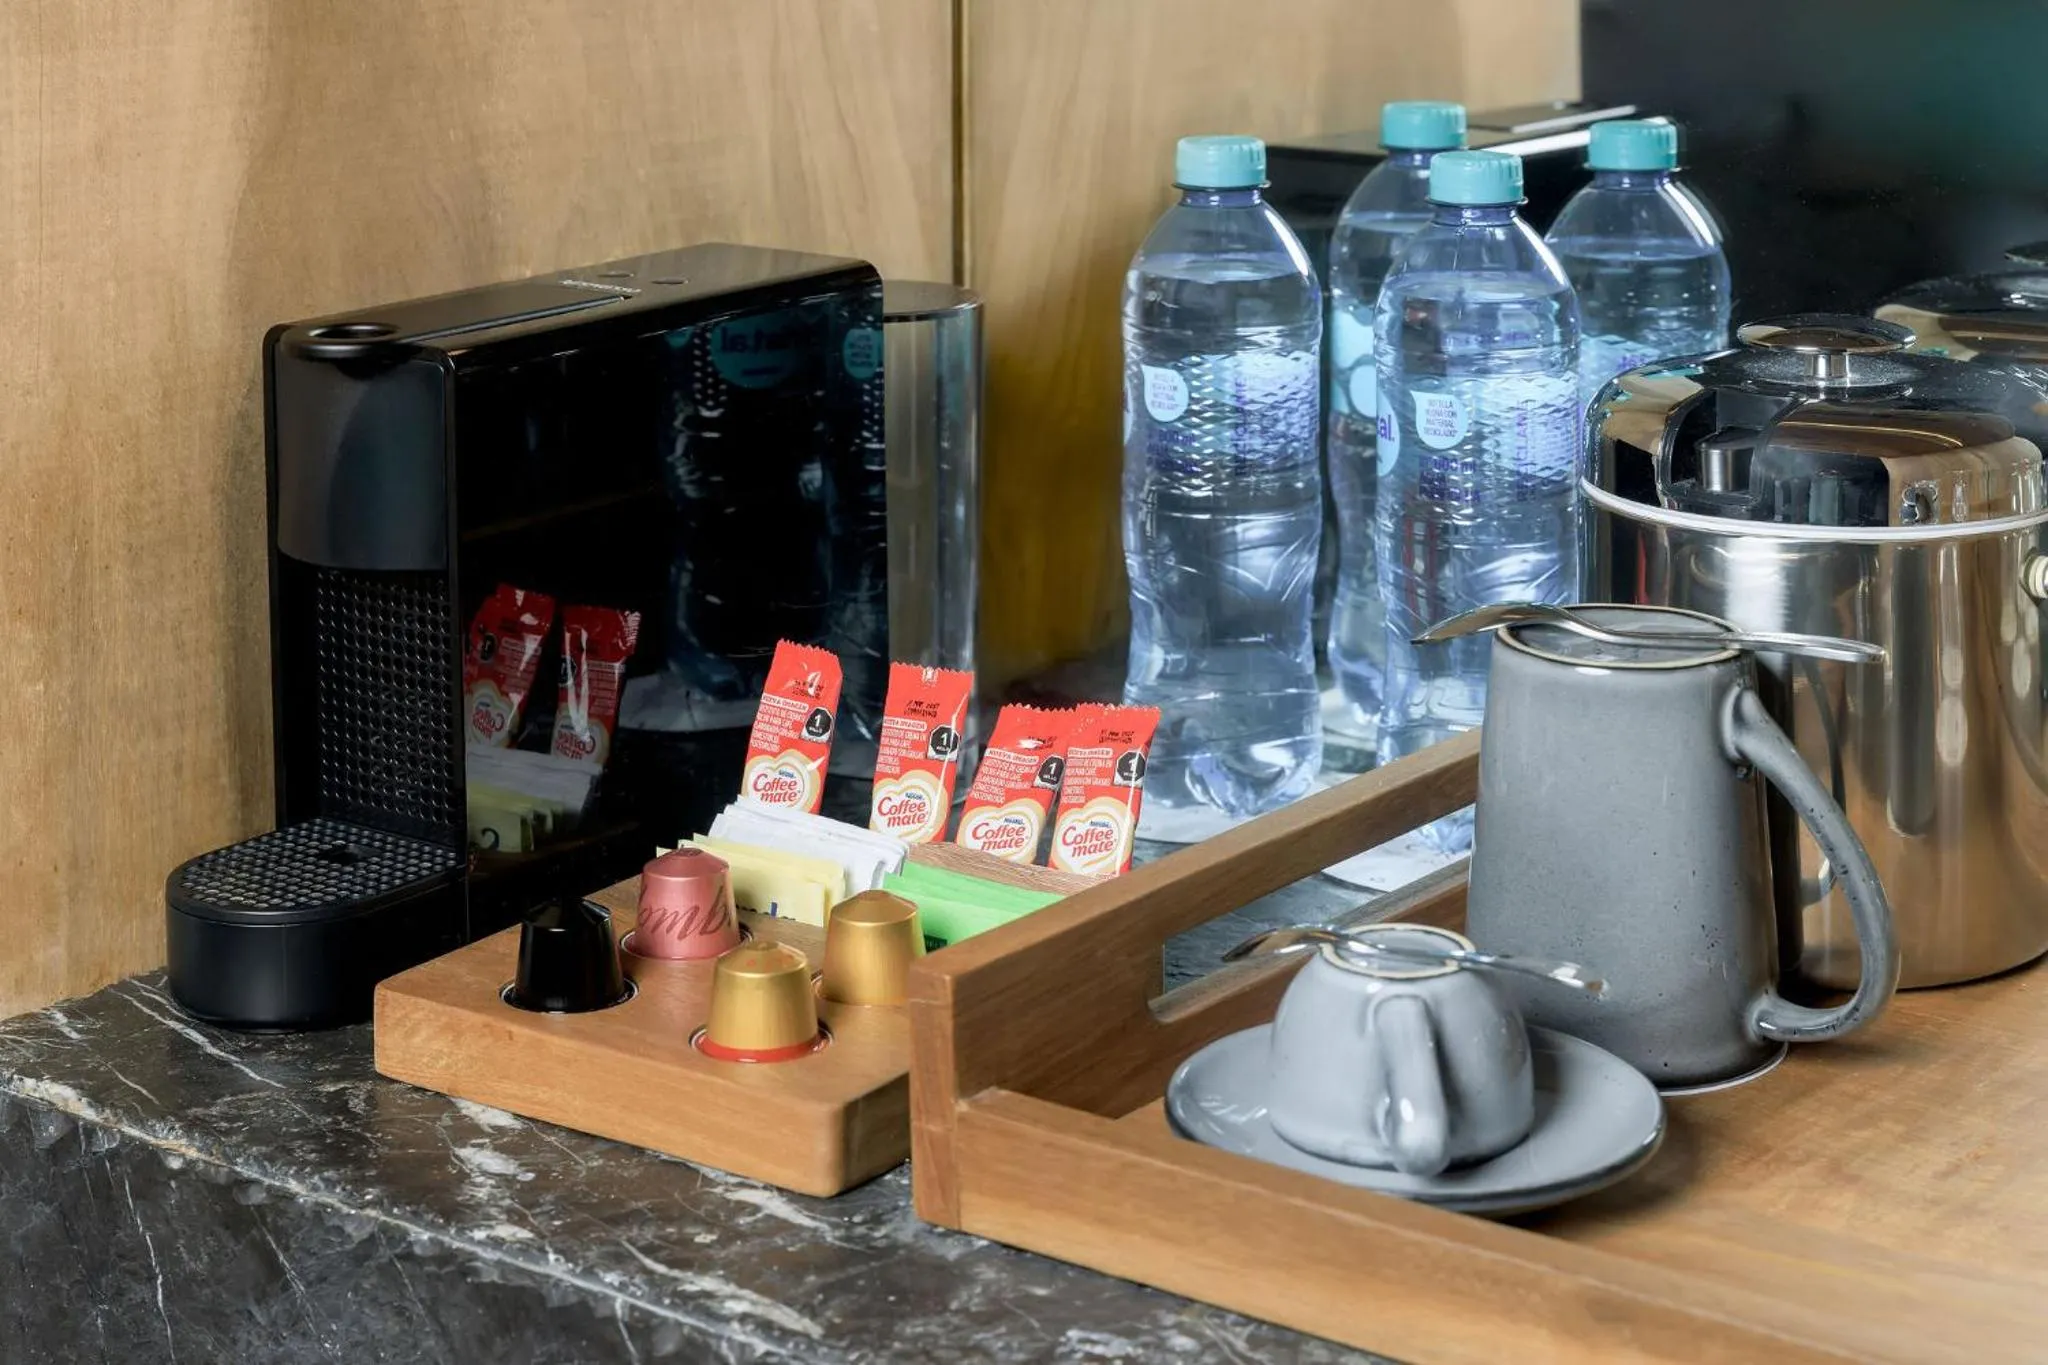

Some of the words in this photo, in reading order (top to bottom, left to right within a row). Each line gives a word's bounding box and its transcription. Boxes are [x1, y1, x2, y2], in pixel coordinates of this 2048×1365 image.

[814, 715, 820, 727] 1
[941, 733, 947, 746] 1
[1050, 762, 1057, 775] 1
[753, 773, 798, 794] Coffee
[760, 789, 798, 803] mate
[878, 797, 926, 817] Coffee
[887, 811, 927, 828] mate
[972, 822, 1026, 841] Coffee
[1062, 826, 1114, 847] Coffee
[981, 836, 1024, 851] mate
[1071, 840, 1114, 858] mate
